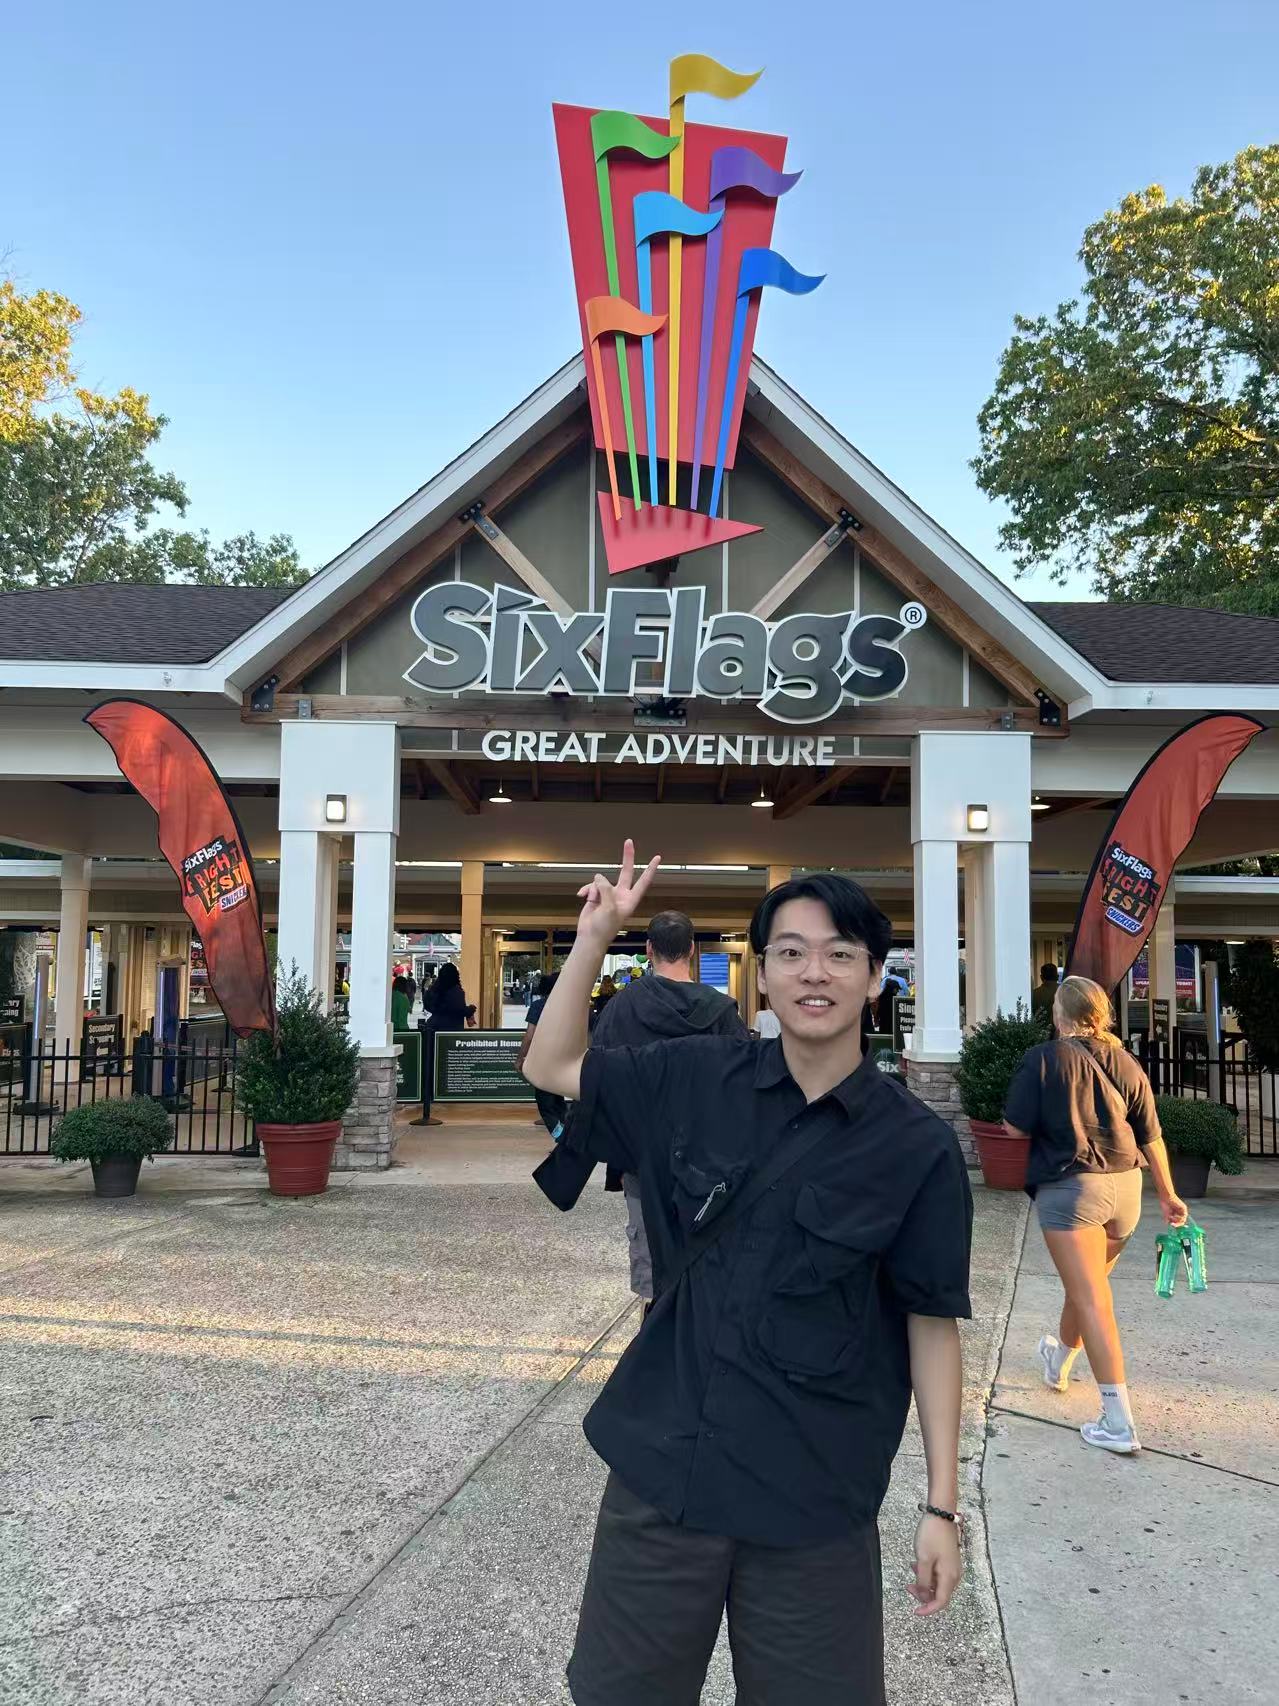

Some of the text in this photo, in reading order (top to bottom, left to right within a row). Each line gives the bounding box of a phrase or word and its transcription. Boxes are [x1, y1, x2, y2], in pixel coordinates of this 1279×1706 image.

[481, 730, 836, 767] GREAT ADVENTURE
[184, 840, 223, 873] SixFlags
[185, 847, 240, 895] FRIGHT
[1111, 847, 1154, 880] SixFlags
[202, 867, 243, 908] FEST
[1102, 858, 1157, 903] FRIGHT
[1103, 881, 1147, 918] FEST
[1106, 907, 1140, 932] SNICKERS
